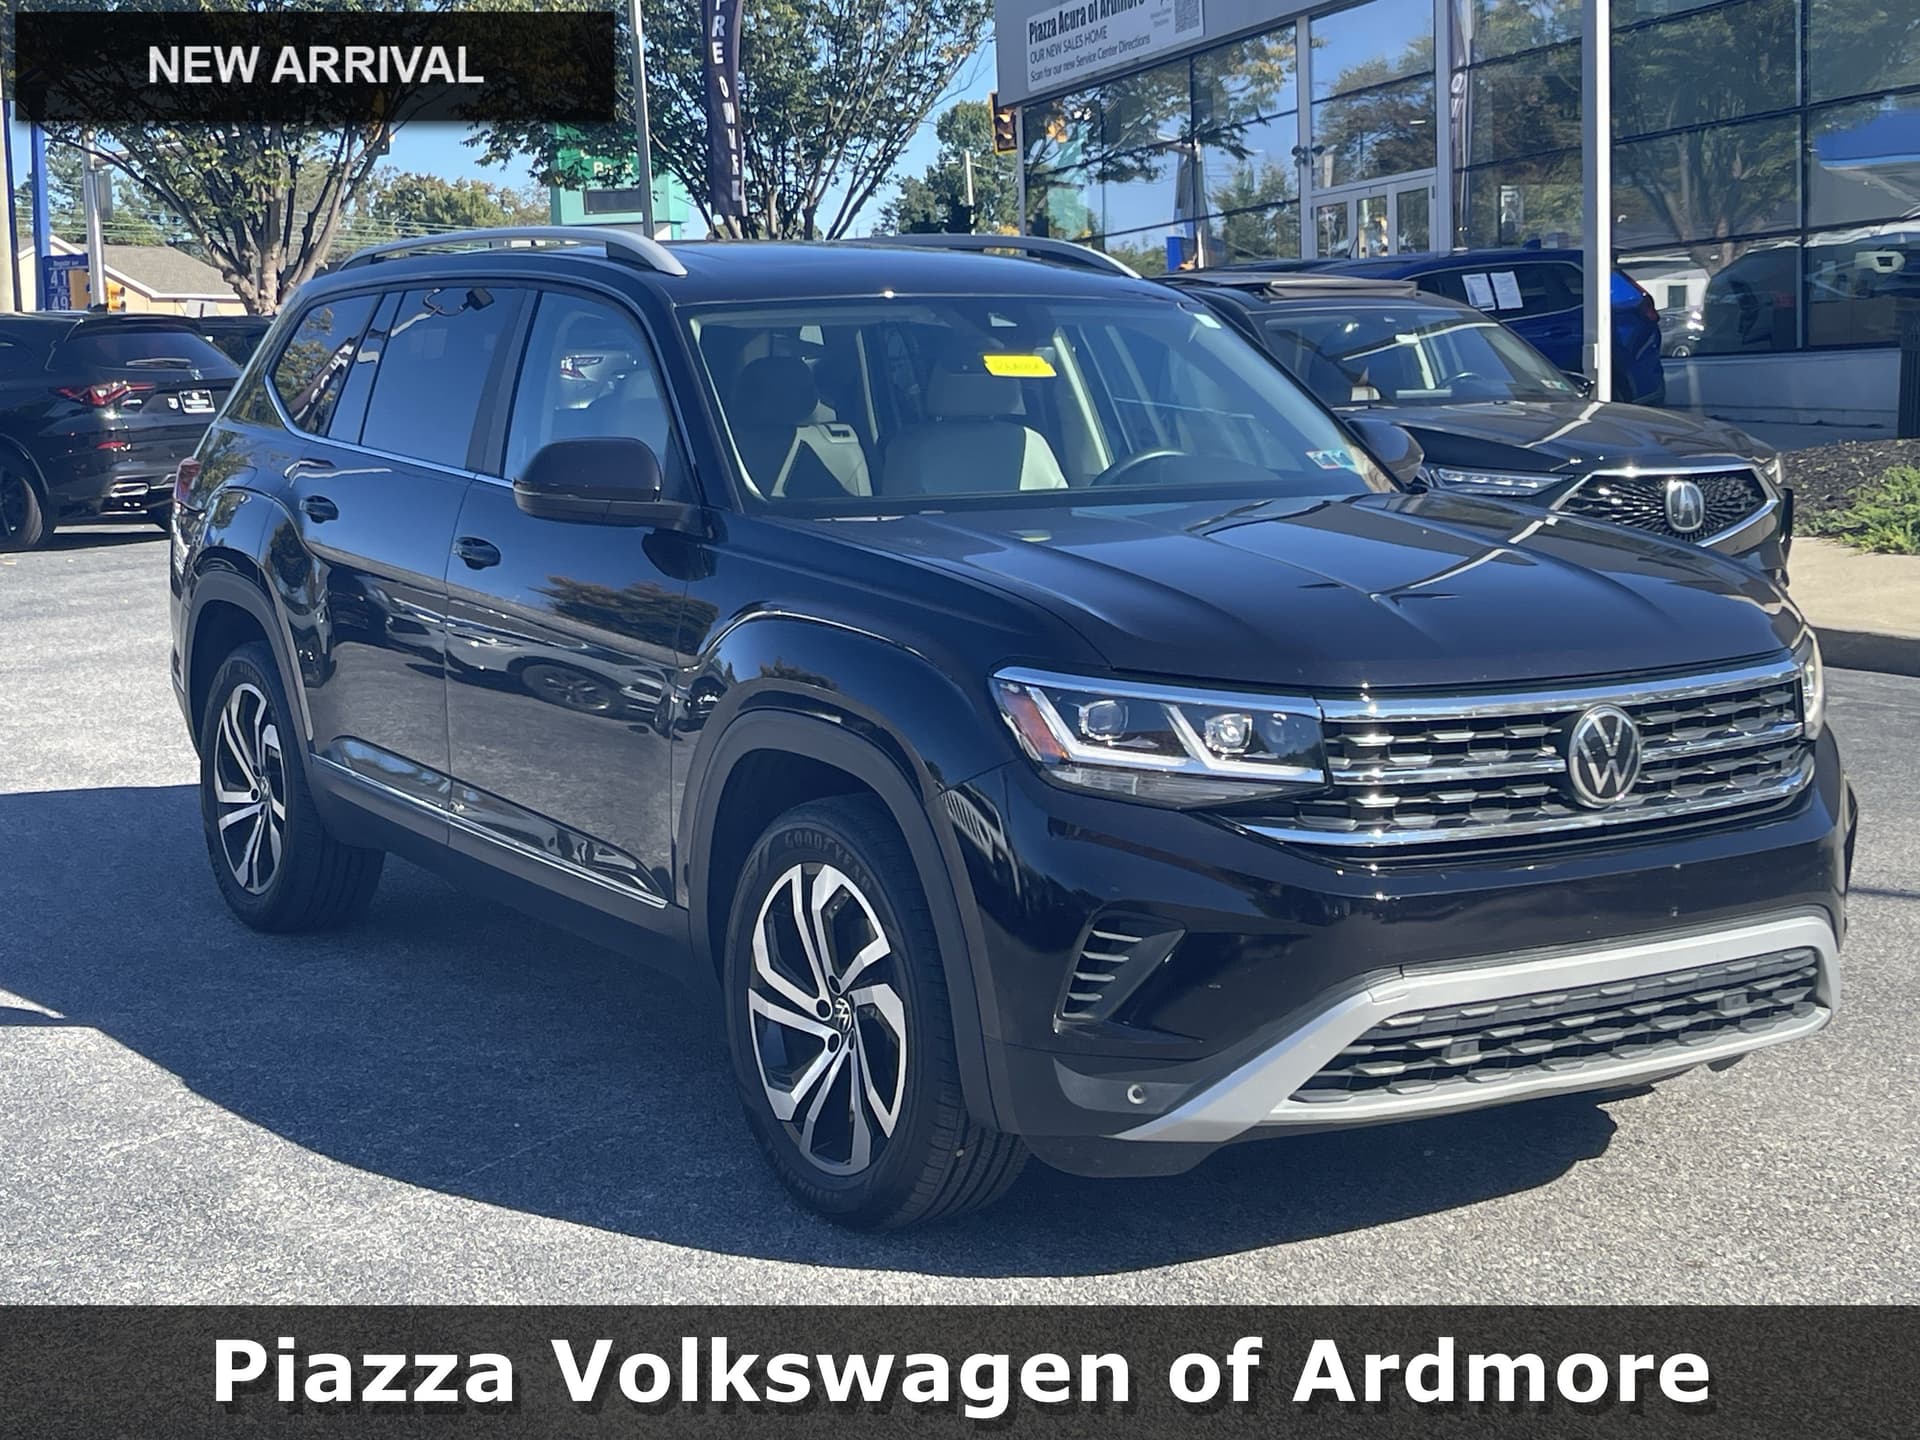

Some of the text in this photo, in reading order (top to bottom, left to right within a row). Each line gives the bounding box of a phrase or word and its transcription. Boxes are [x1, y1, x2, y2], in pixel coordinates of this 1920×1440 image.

[1029, 17, 1057, 45] Piazza
[1058, 6, 1087, 35] Acura
[1088, 0, 1098, 23] of
[1100, 0, 1145, 19] Ardmo
[1030, 25, 1108, 64] OUR NEW SALES HOME
[1031, 33, 1151, 82] Scan for our new Service Center Directions
[593, 160, 634, 177] Bak
[1574, 708, 1638, 801] VW
